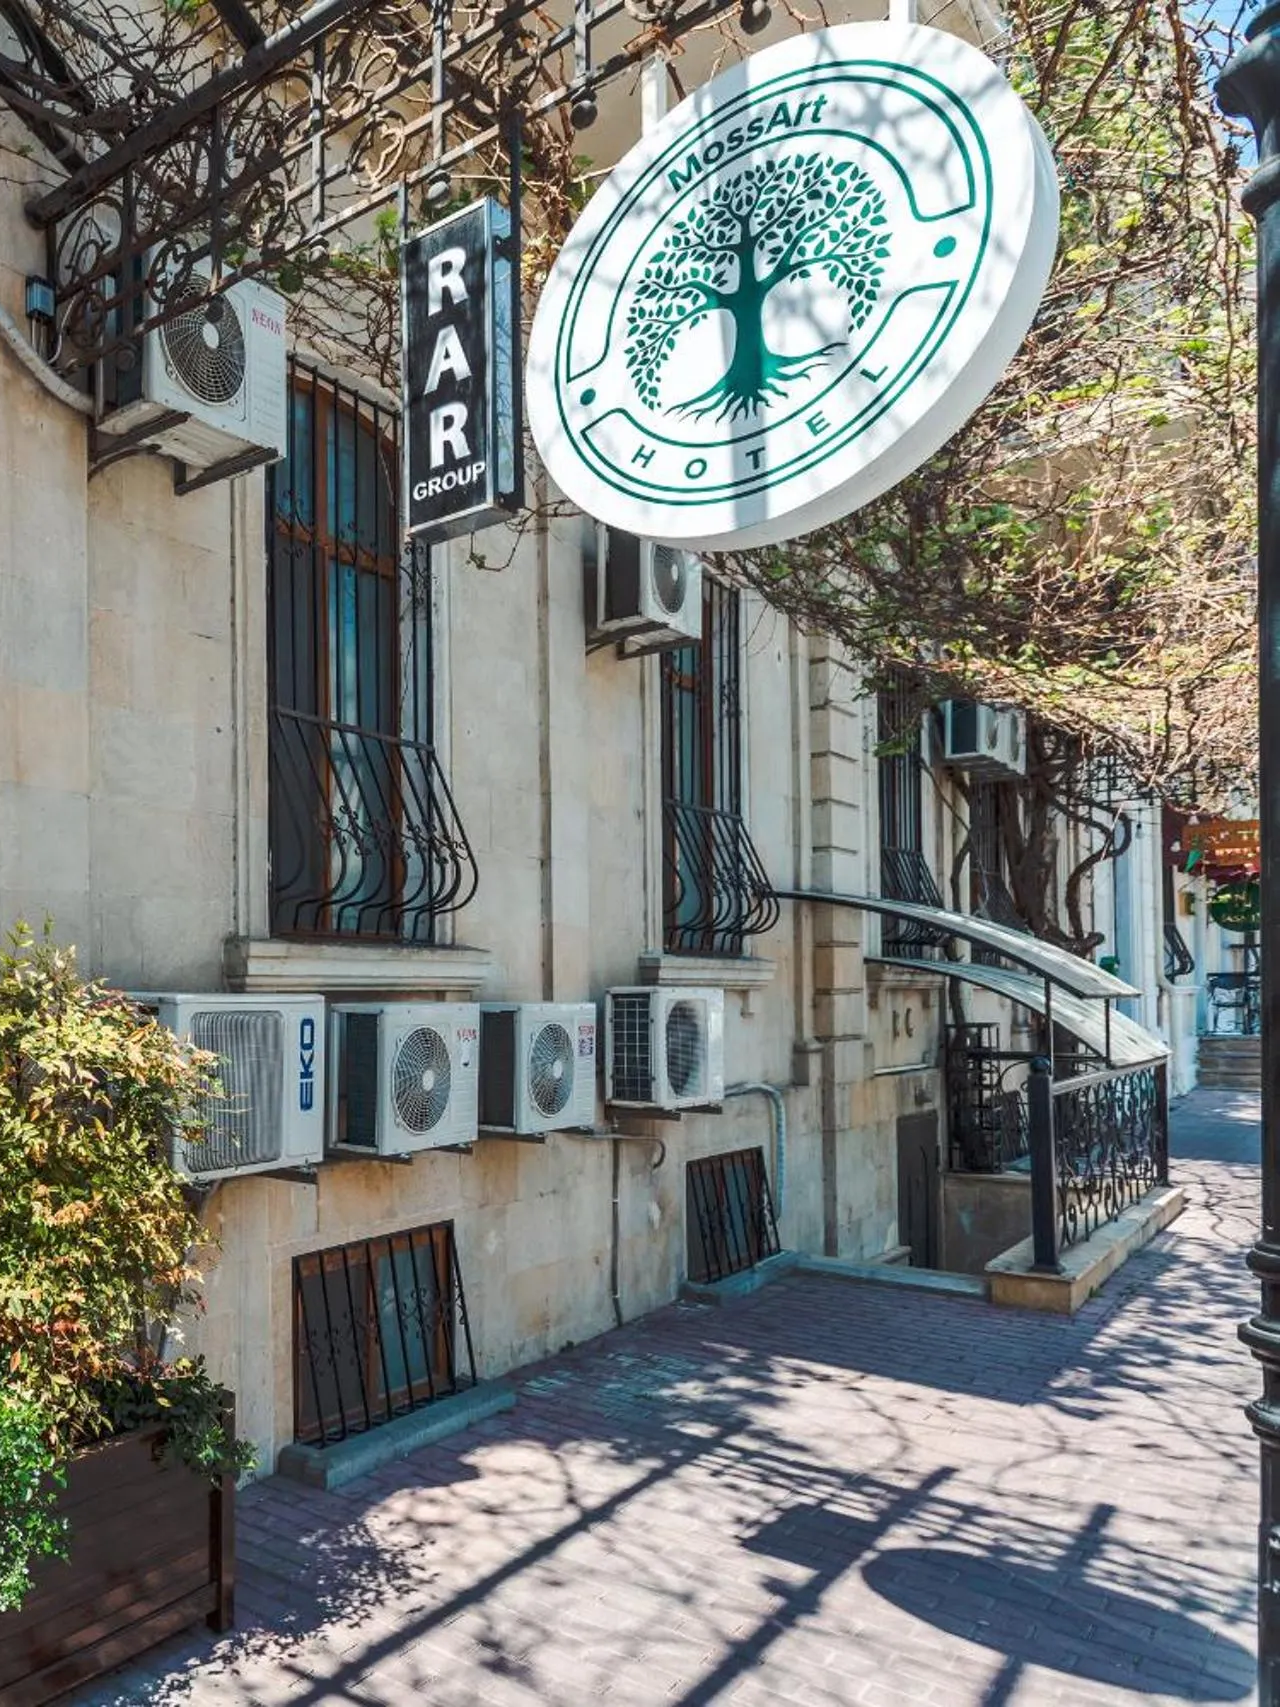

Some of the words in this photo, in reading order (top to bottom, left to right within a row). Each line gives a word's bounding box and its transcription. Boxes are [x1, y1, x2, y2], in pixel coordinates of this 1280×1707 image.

[666, 94, 828, 194] MossArt
[251, 307, 283, 336] NEON
[424, 247, 473, 469] RAR
[630, 364, 890, 480] HOTEL
[412, 461, 487, 501] GROUP
[300, 1018, 314, 1111] EKO
